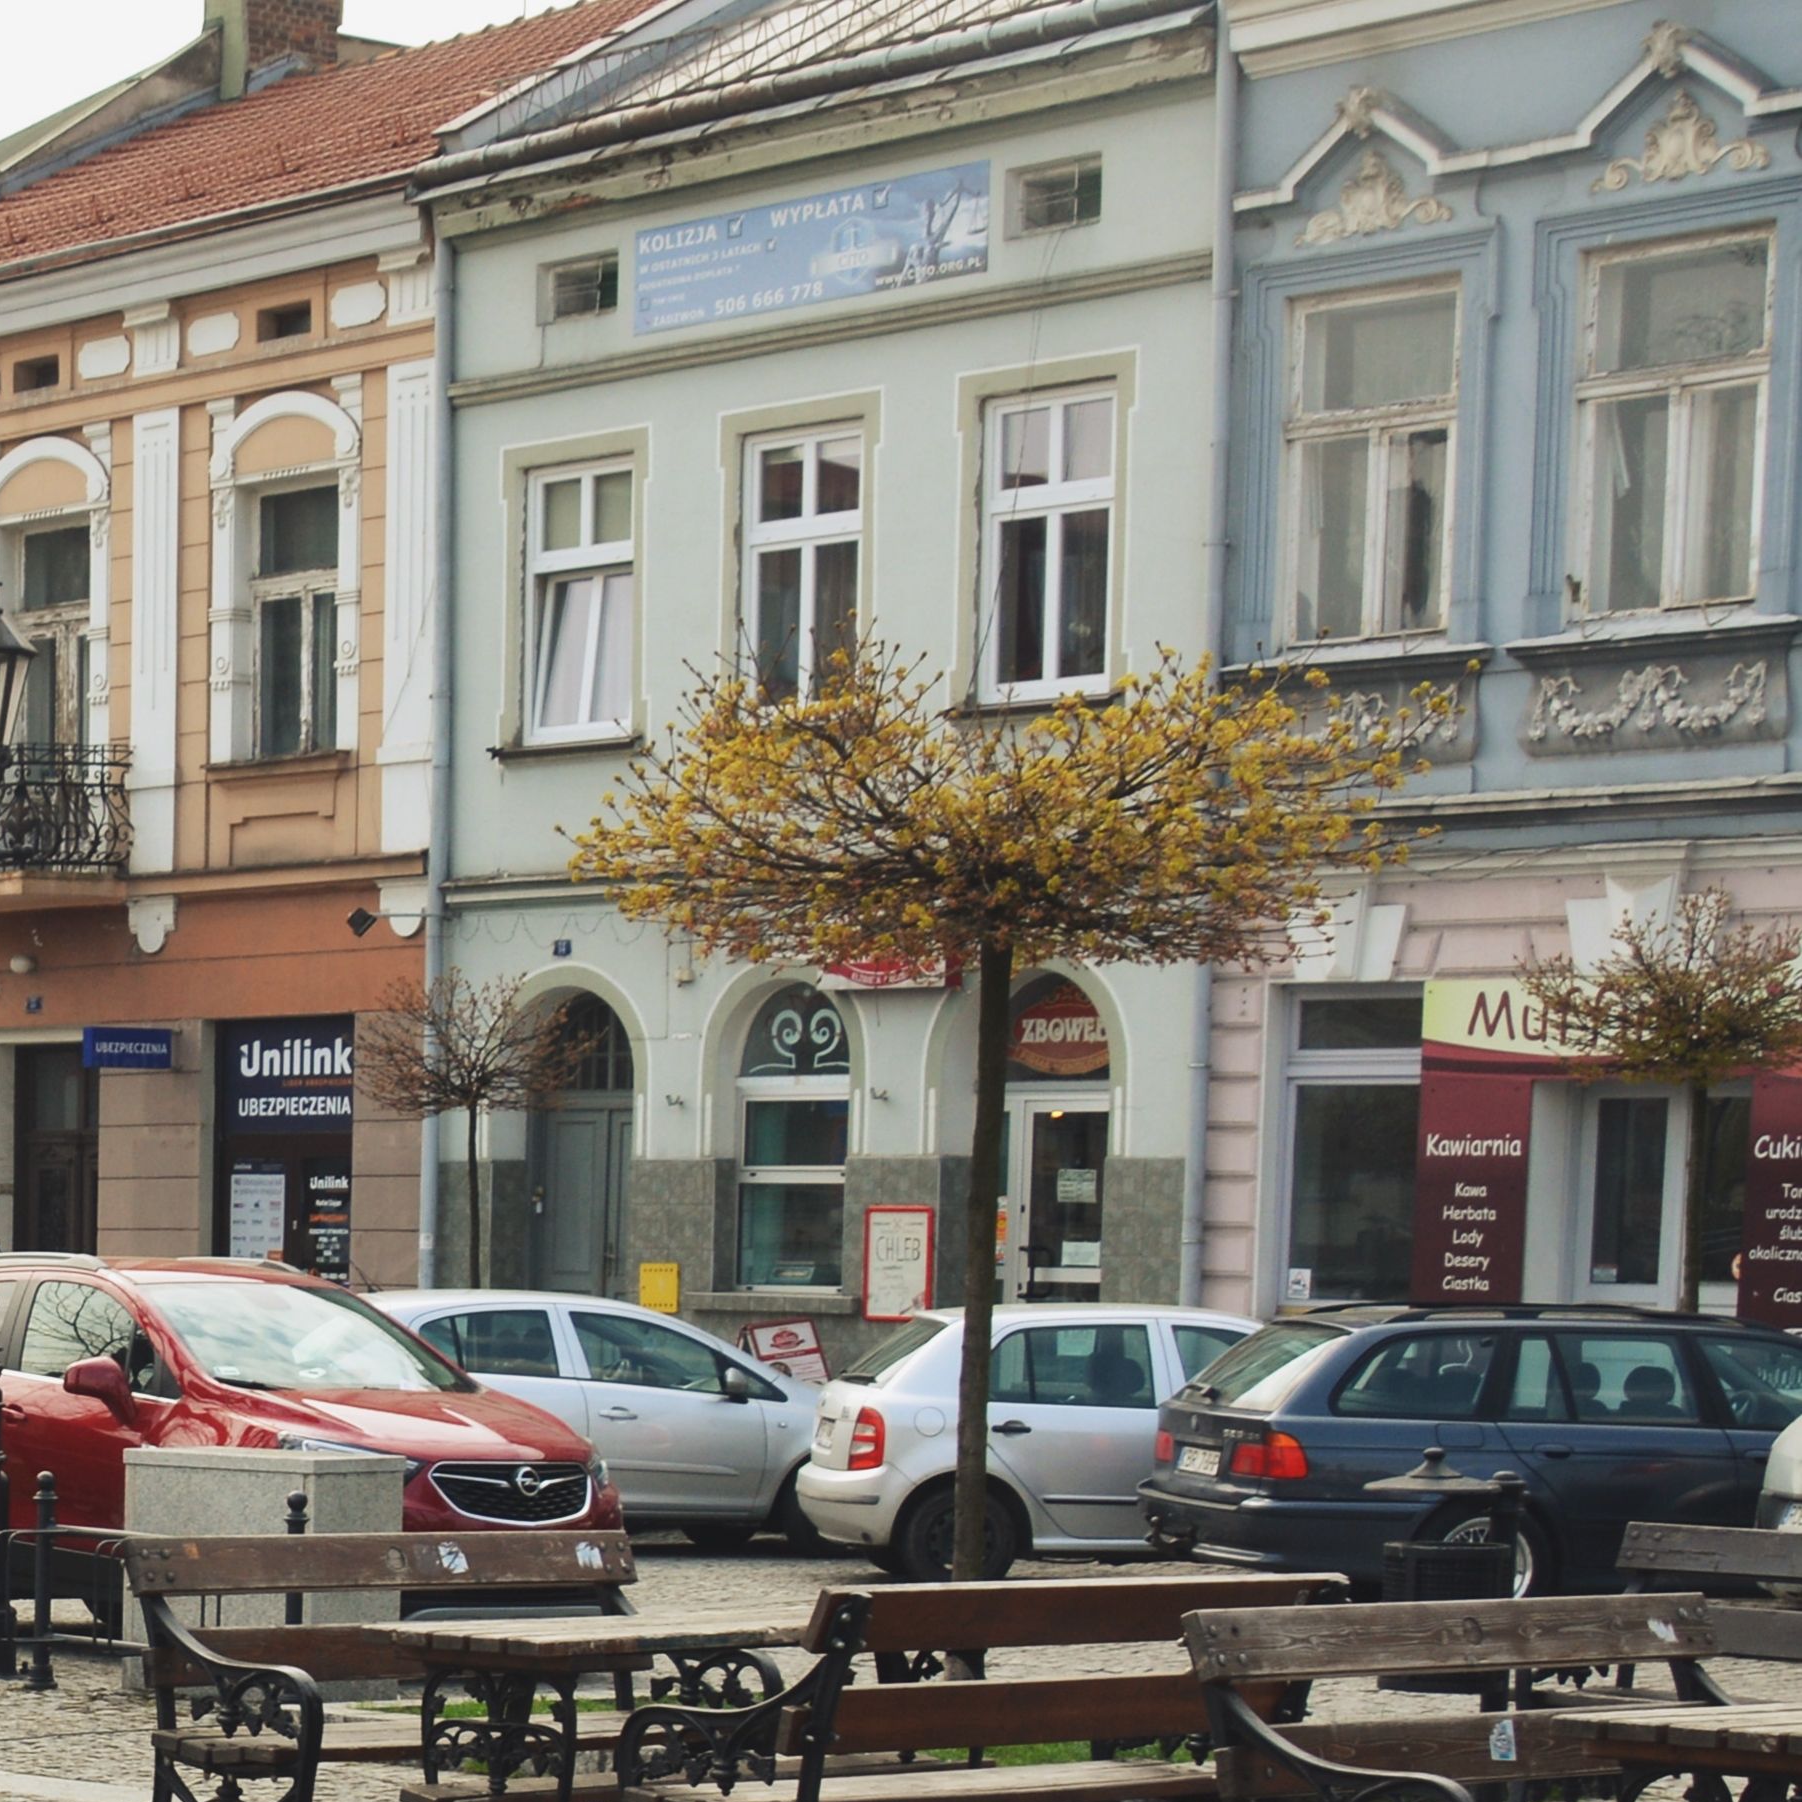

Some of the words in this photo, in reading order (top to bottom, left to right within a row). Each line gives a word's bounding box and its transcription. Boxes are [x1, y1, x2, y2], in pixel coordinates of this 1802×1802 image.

[639, 225, 718, 255] KOLIZJA
[770, 193, 866, 228] WYPŁATA
[715, 295, 747, 315] 506
[752, 288, 785, 308] 666
[791, 281, 823, 304] 778
[95, 1041, 168, 1055] UBEZPIECZENIA
[239, 1037, 353, 1078] Unilink
[238, 1096, 352, 1118] UBEZPIECZENIA
[1426, 1133, 1521, 1157] Kawiarnia
[1754, 1134, 1802, 1159] Cuki
[310, 1176, 349, 1190] Unilink
[1454, 1182, 1488, 1197] Kawa
[1442, 1205, 1497, 1221] Herbata
[1452, 1229, 1484, 1248] Lody
[876, 1236, 921, 1262] CHLEB
[1443, 1252, 1491, 1271] Desery
[1442, 1275, 1490, 1291] Ciastka
